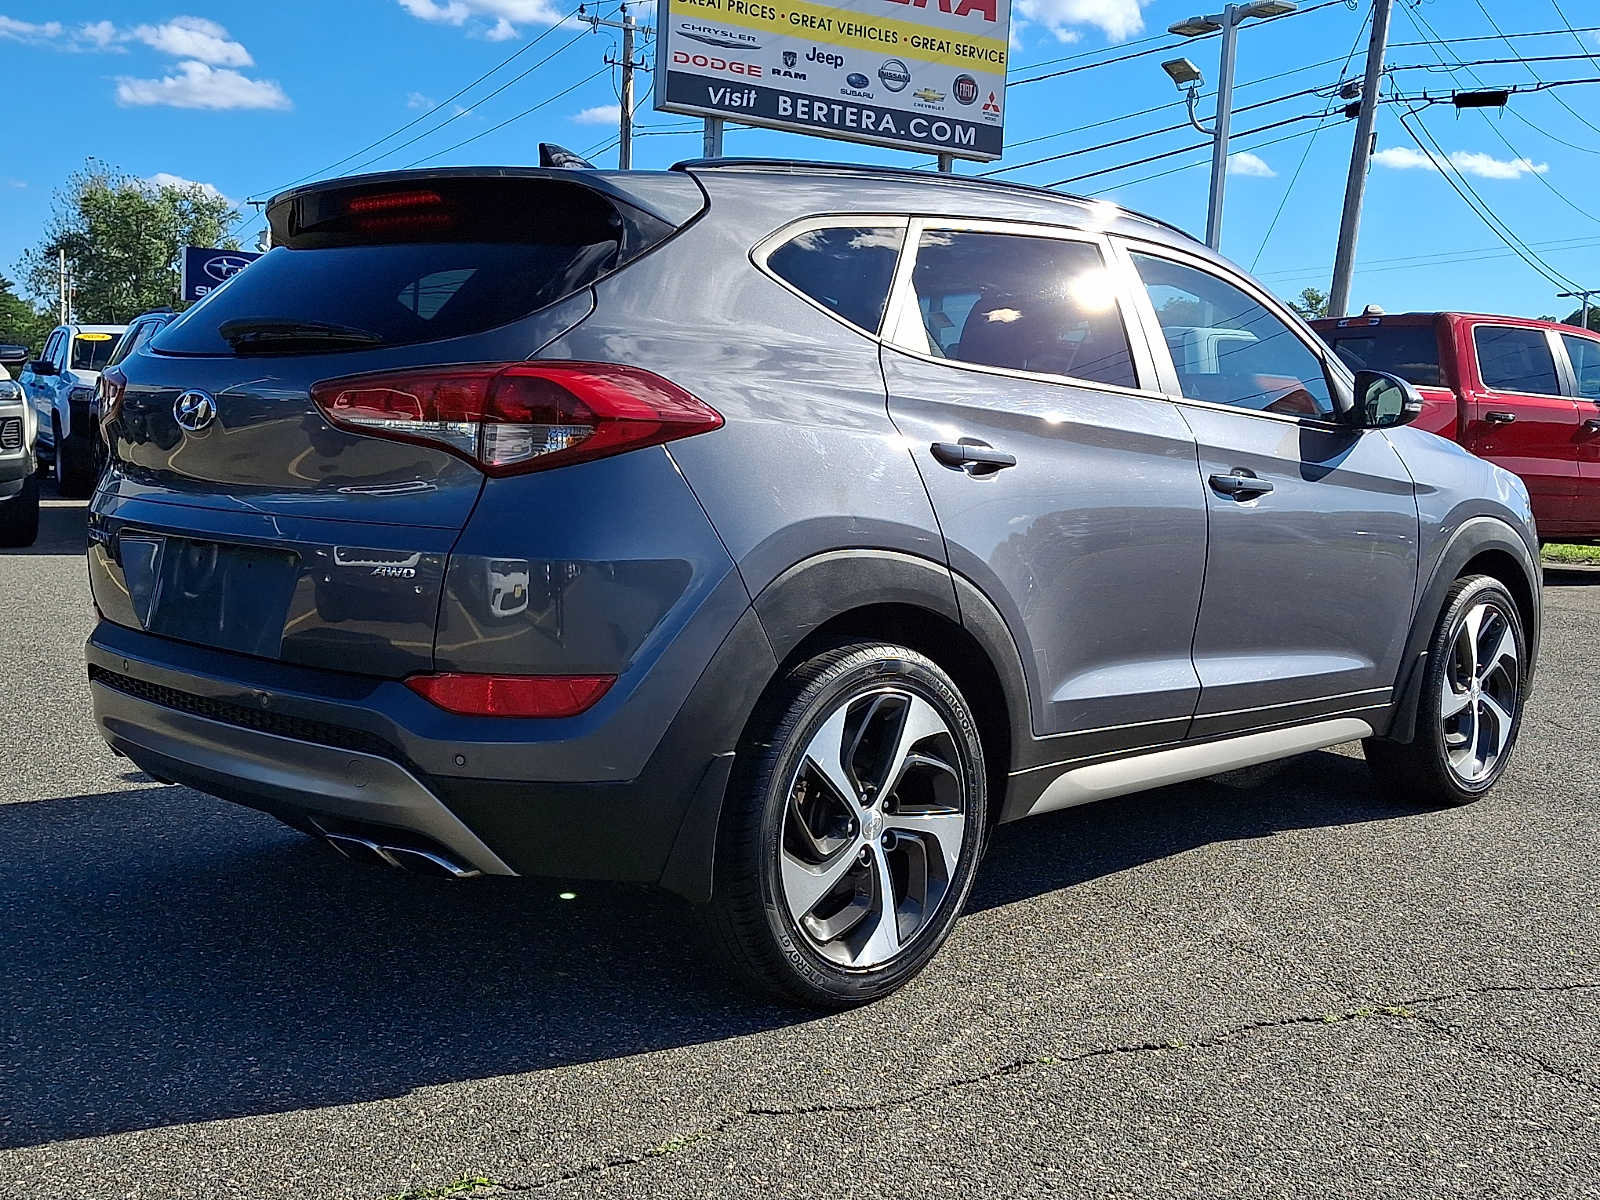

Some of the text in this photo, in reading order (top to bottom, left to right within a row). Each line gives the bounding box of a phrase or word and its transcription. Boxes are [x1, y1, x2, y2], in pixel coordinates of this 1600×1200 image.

[681, 23, 757, 43] CHRYSLER
[728, 0, 776, 20] PRICES
[789, 12, 833, 32] GREAT
[837, 20, 899, 44] VEHICLES
[910, 35, 951, 54] GREAT
[955, 43, 1005, 65] SERVICE
[673, 51, 763, 78] DODGE
[806, 47, 844, 70] Jeep
[771, 68, 807, 81] RAM
[881, 70, 909, 83] NISSAN
[840, 88, 875, 100] SUBARU
[960, 83, 974, 98] FIAT
[708, 86, 976, 147] Visit BERTERA.COM
